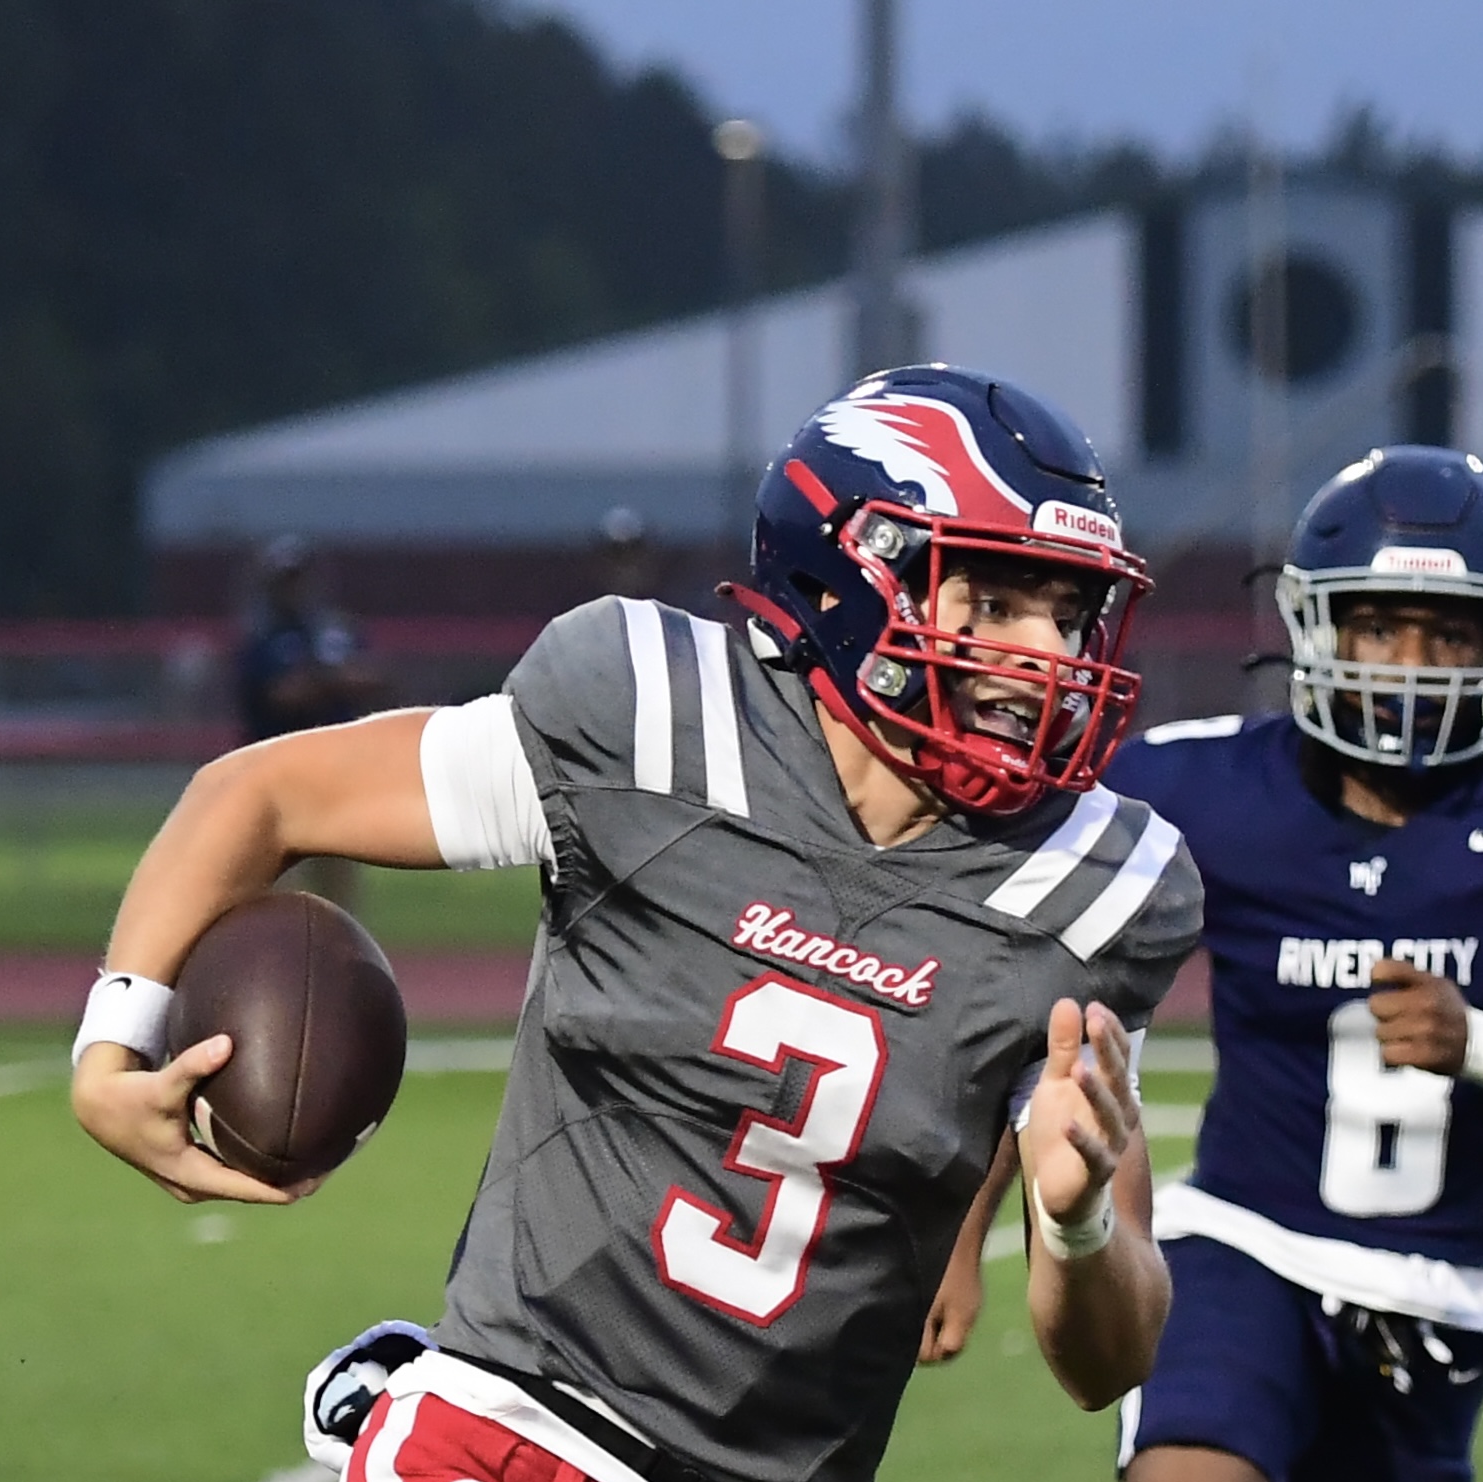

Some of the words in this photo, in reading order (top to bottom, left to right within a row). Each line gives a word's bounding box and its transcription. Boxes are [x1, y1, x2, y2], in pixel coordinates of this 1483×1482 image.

[1054, 507, 1115, 541] Riddell
[731, 899, 942, 1007] Hancock
[1277, 936, 1385, 989] RIVER
[650, 970, 889, 1328] 3
[1319, 998, 1455, 1218] 6
